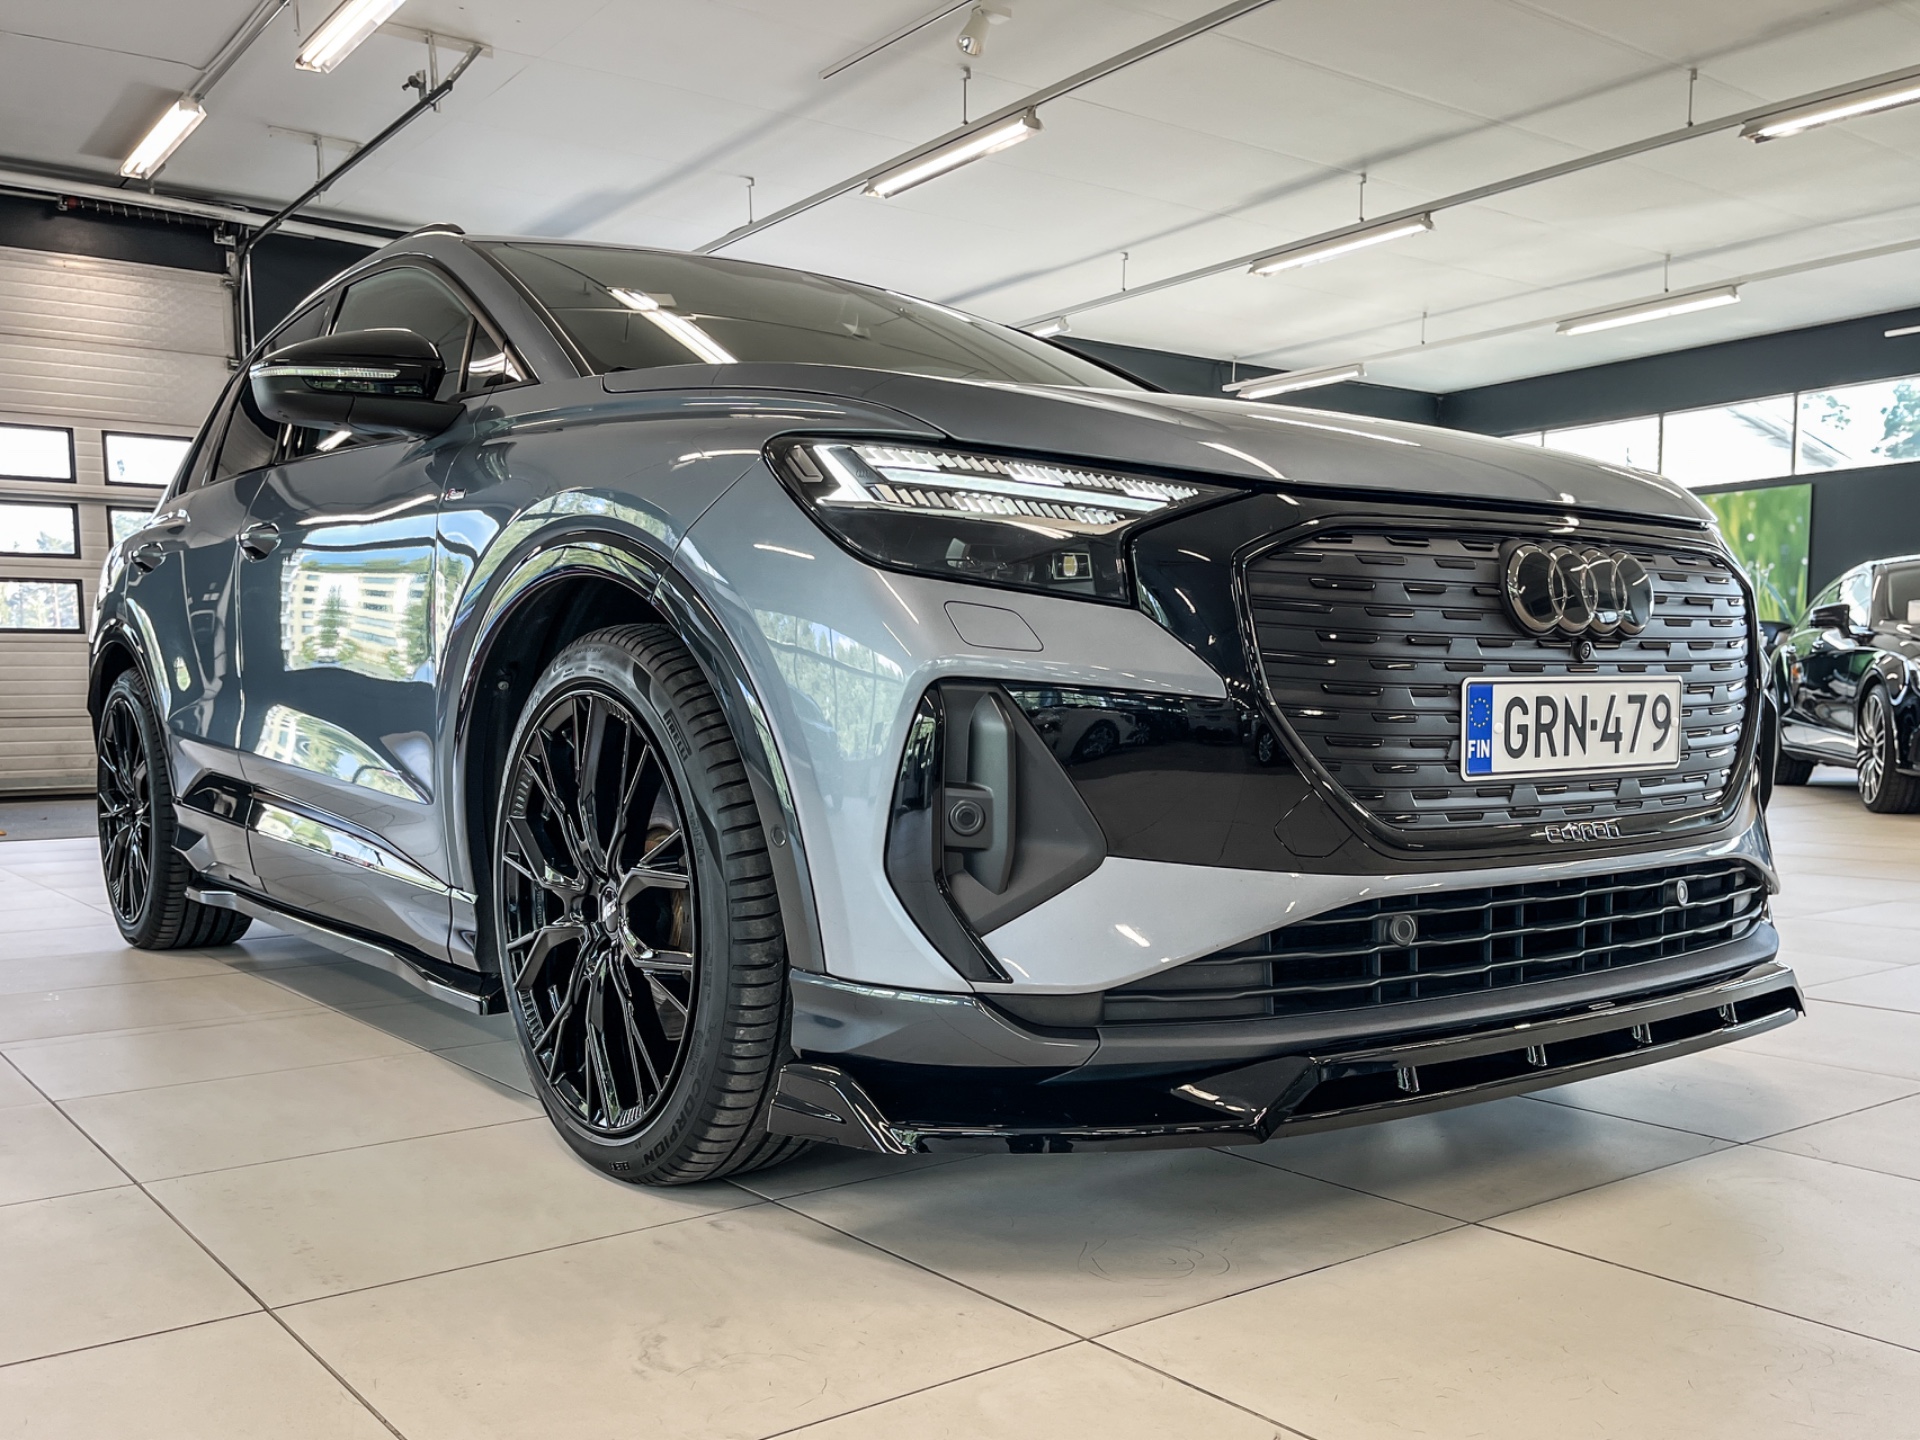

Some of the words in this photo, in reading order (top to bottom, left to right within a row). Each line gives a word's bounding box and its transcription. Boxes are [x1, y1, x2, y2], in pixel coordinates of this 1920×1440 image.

[663, 708, 692, 762] PIRELLI
[1467, 740, 1490, 759] FIN
[1503, 694, 1672, 759] GRN-479
